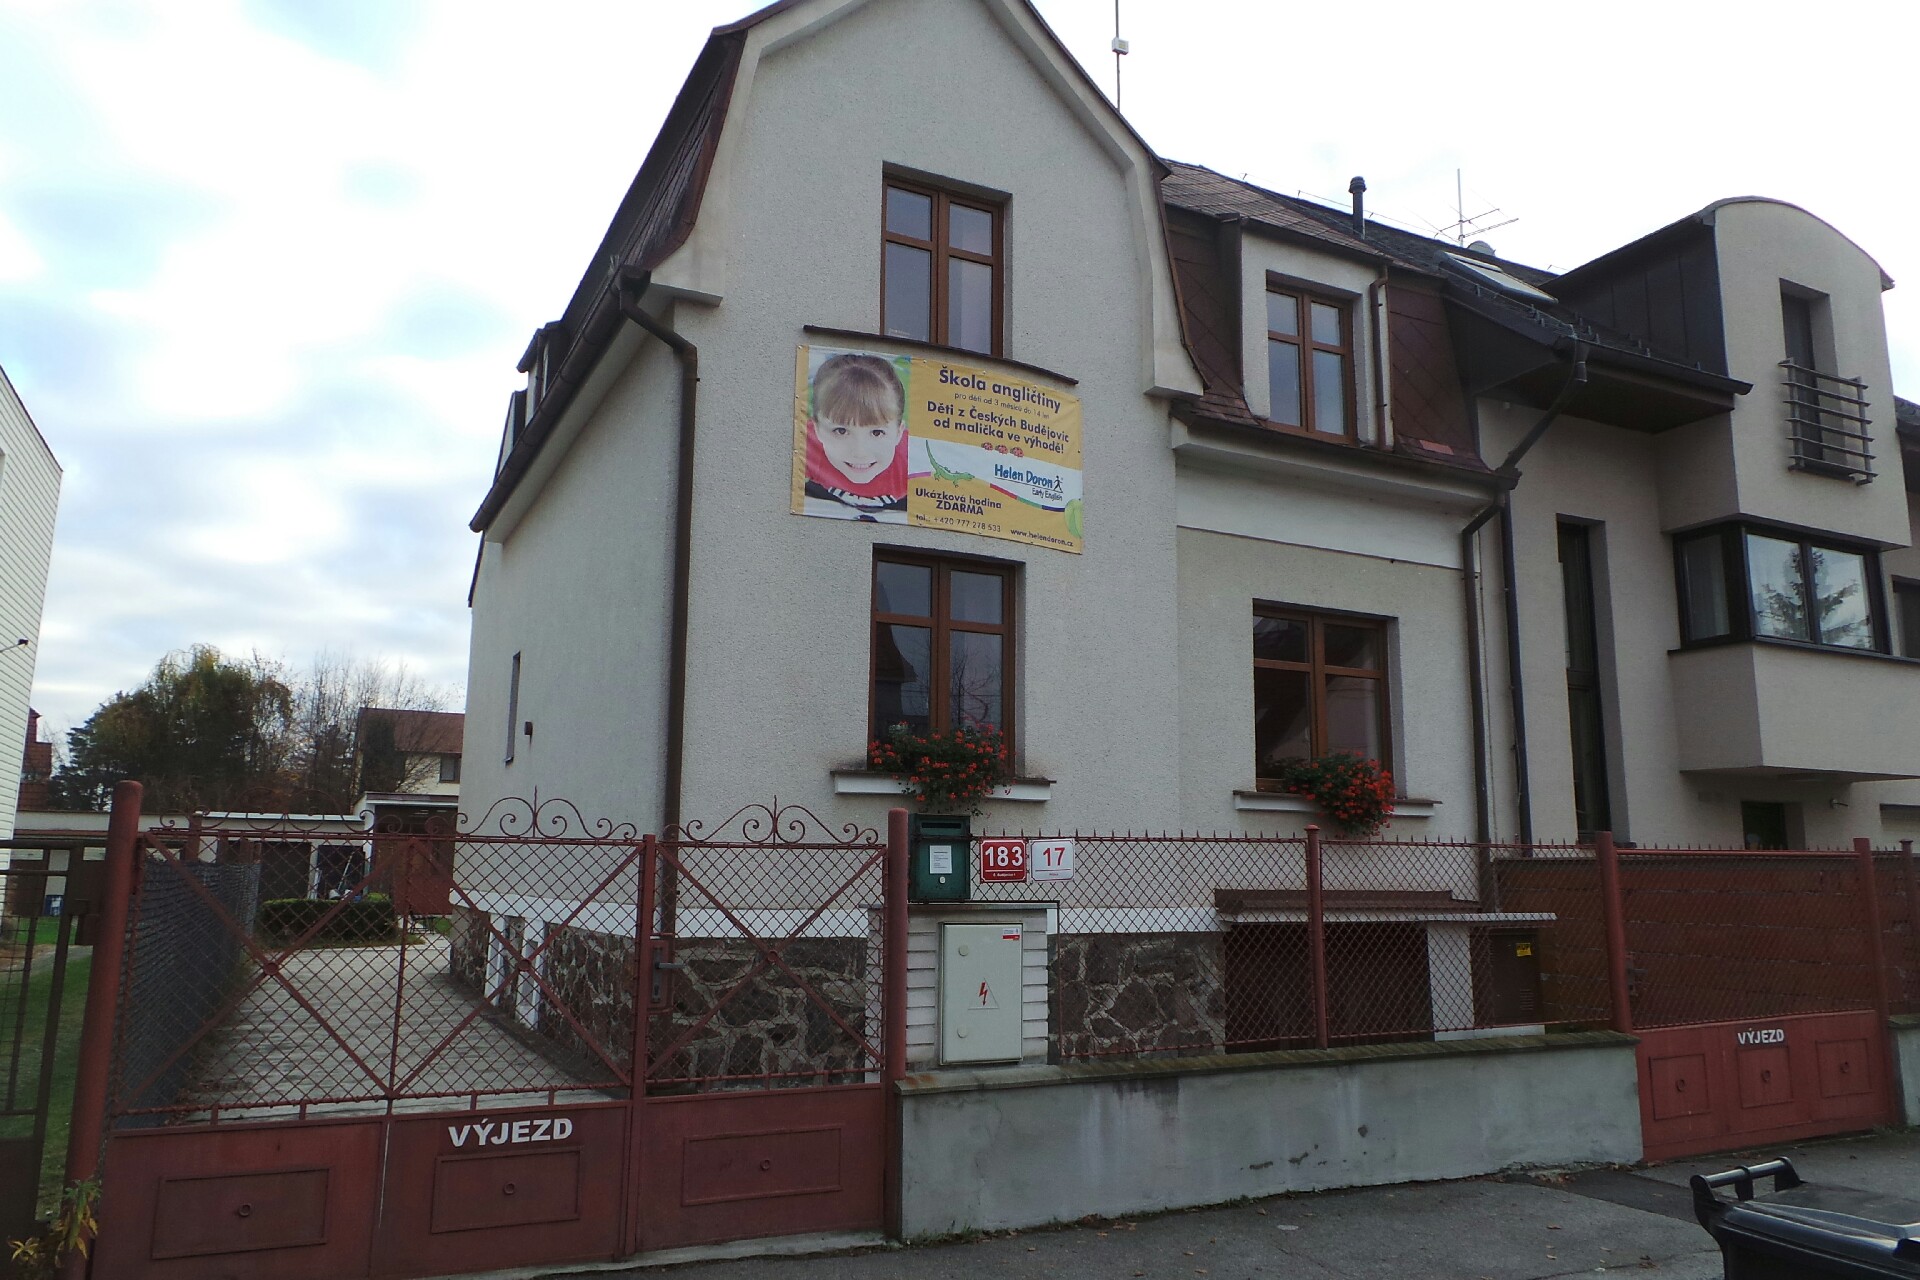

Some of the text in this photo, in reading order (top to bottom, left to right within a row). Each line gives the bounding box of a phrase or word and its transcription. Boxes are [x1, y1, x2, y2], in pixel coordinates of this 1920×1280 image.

[939, 364, 1061, 413] Škola angličtiny
[954, 392, 967, 400] pro
[983, 397, 993, 405] od
[994, 398, 999, 406] 3
[1023, 406, 1032, 414] do
[927, 400, 1070, 443] Děti z Českých Budějovic
[933, 418, 1064, 454] od malička ve výhodě!
[994, 463, 1053, 489] Helen Doron
[915, 487, 1002, 509] Ukázková hodina
[1032, 487, 1063, 502] Early English
[935, 500, 984, 516] ZDARMA
[933, 517, 954, 525] +420
[956, 518, 970, 527] 777
[984, 846, 1023, 867] 183
[1043, 847, 1066, 867] 17
[1737, 1027, 1785, 1045] VÝJEZD
[447, 1117, 573, 1148] VÝJEZD
